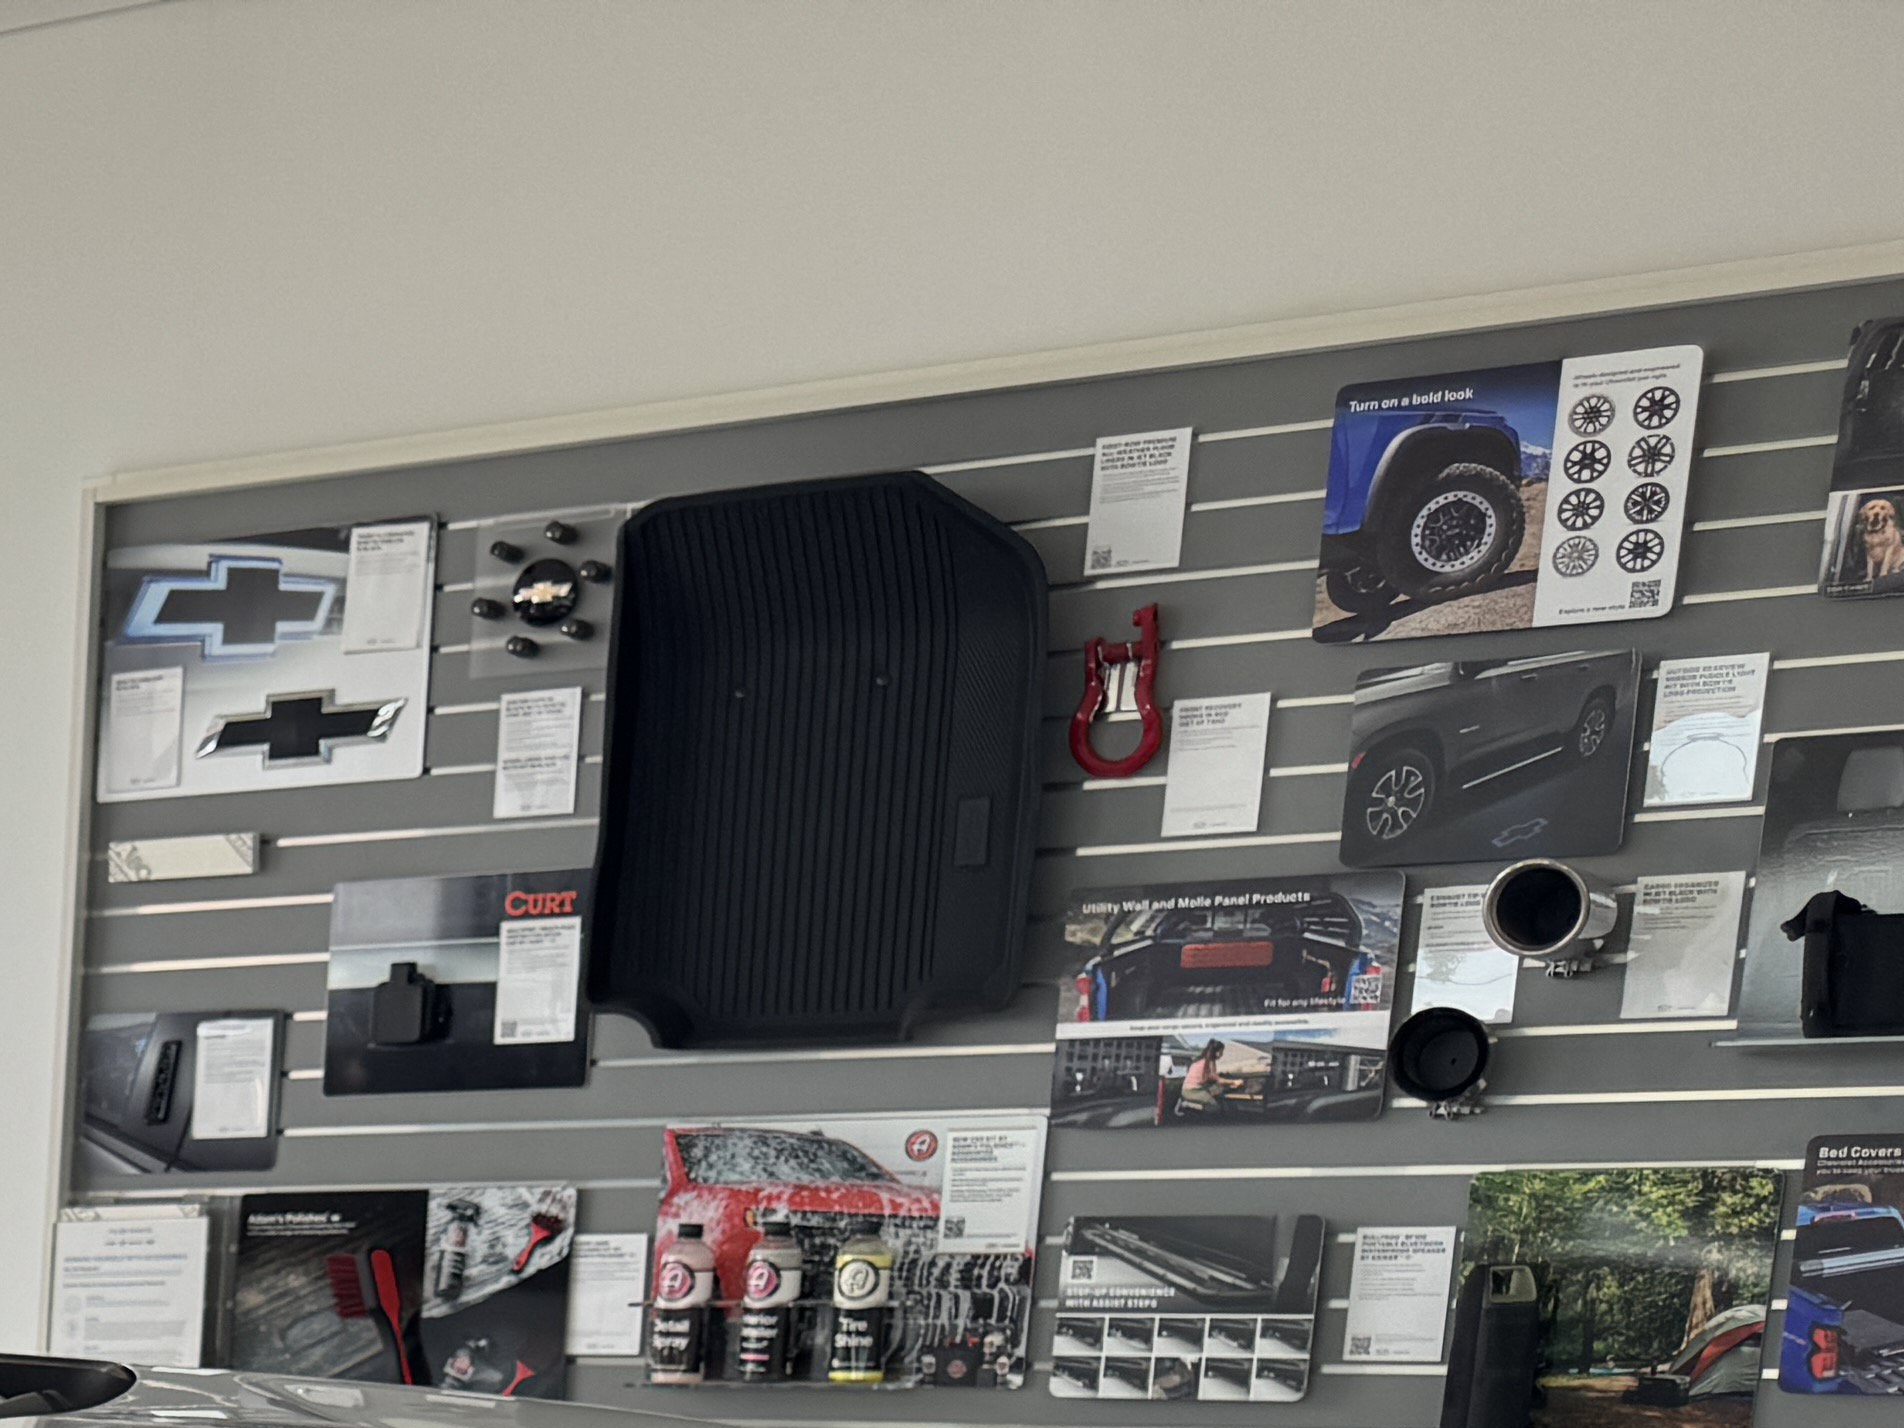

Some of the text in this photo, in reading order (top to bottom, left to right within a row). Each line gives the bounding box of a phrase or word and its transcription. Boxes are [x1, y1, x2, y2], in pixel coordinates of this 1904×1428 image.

[1349, 388, 1473, 413] Turn on a bold look
[505, 890, 578, 917] CURT
[1082, 902, 1120, 914] Utility
[1122, 900, 1150, 912] Wall
[1152, 899, 1175, 910] and
[1214, 893, 1249, 906] Panel
[1252, 890, 1310, 904] Products
[1819, 1146, 1902, 1158] Bed Covers
[839, 1316, 869, 1332] Tire
[834, 1333, 874, 1349] Shine
